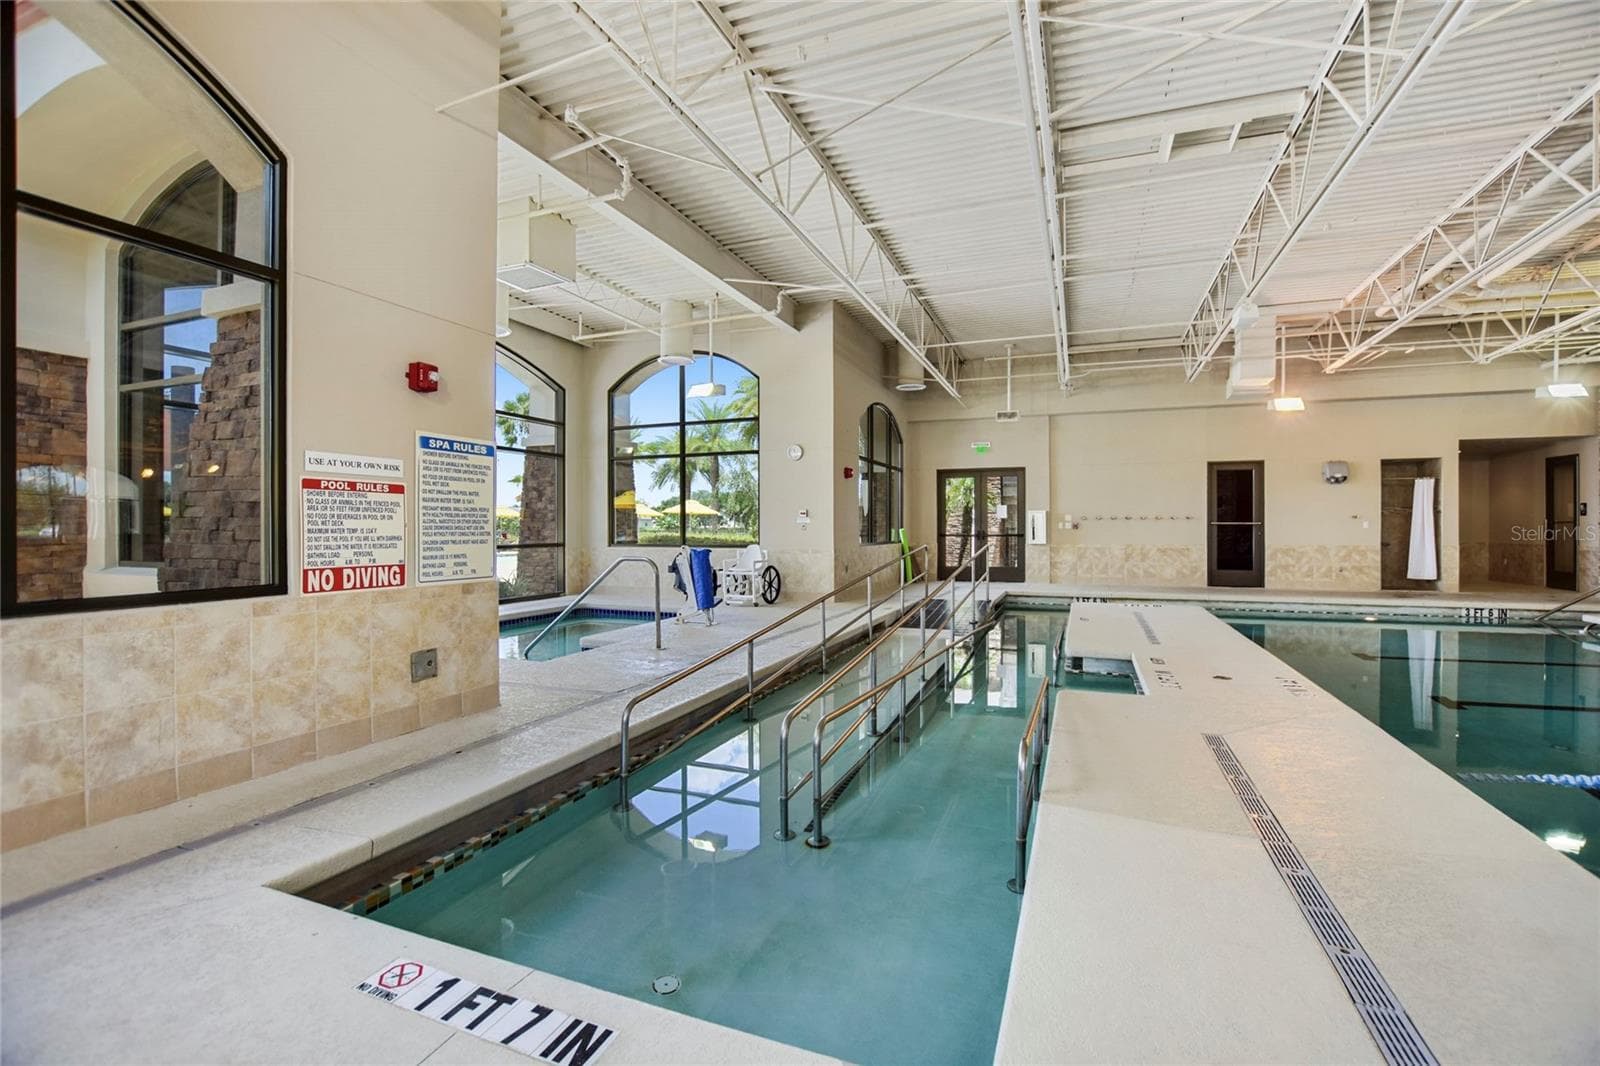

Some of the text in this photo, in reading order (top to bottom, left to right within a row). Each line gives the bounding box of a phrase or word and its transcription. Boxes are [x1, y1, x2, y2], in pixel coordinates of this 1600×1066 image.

[429, 439, 487, 454] SPA RULES
[321, 481, 390, 492] POOL RULES
[308, 566, 400, 592] NO DIVING
[1465, 608, 1507, 617] 3 FT 6 IN
[357, 982, 398, 1002] NO DIVING
[414, 977, 614, 1066] 1 FT 7 IN
